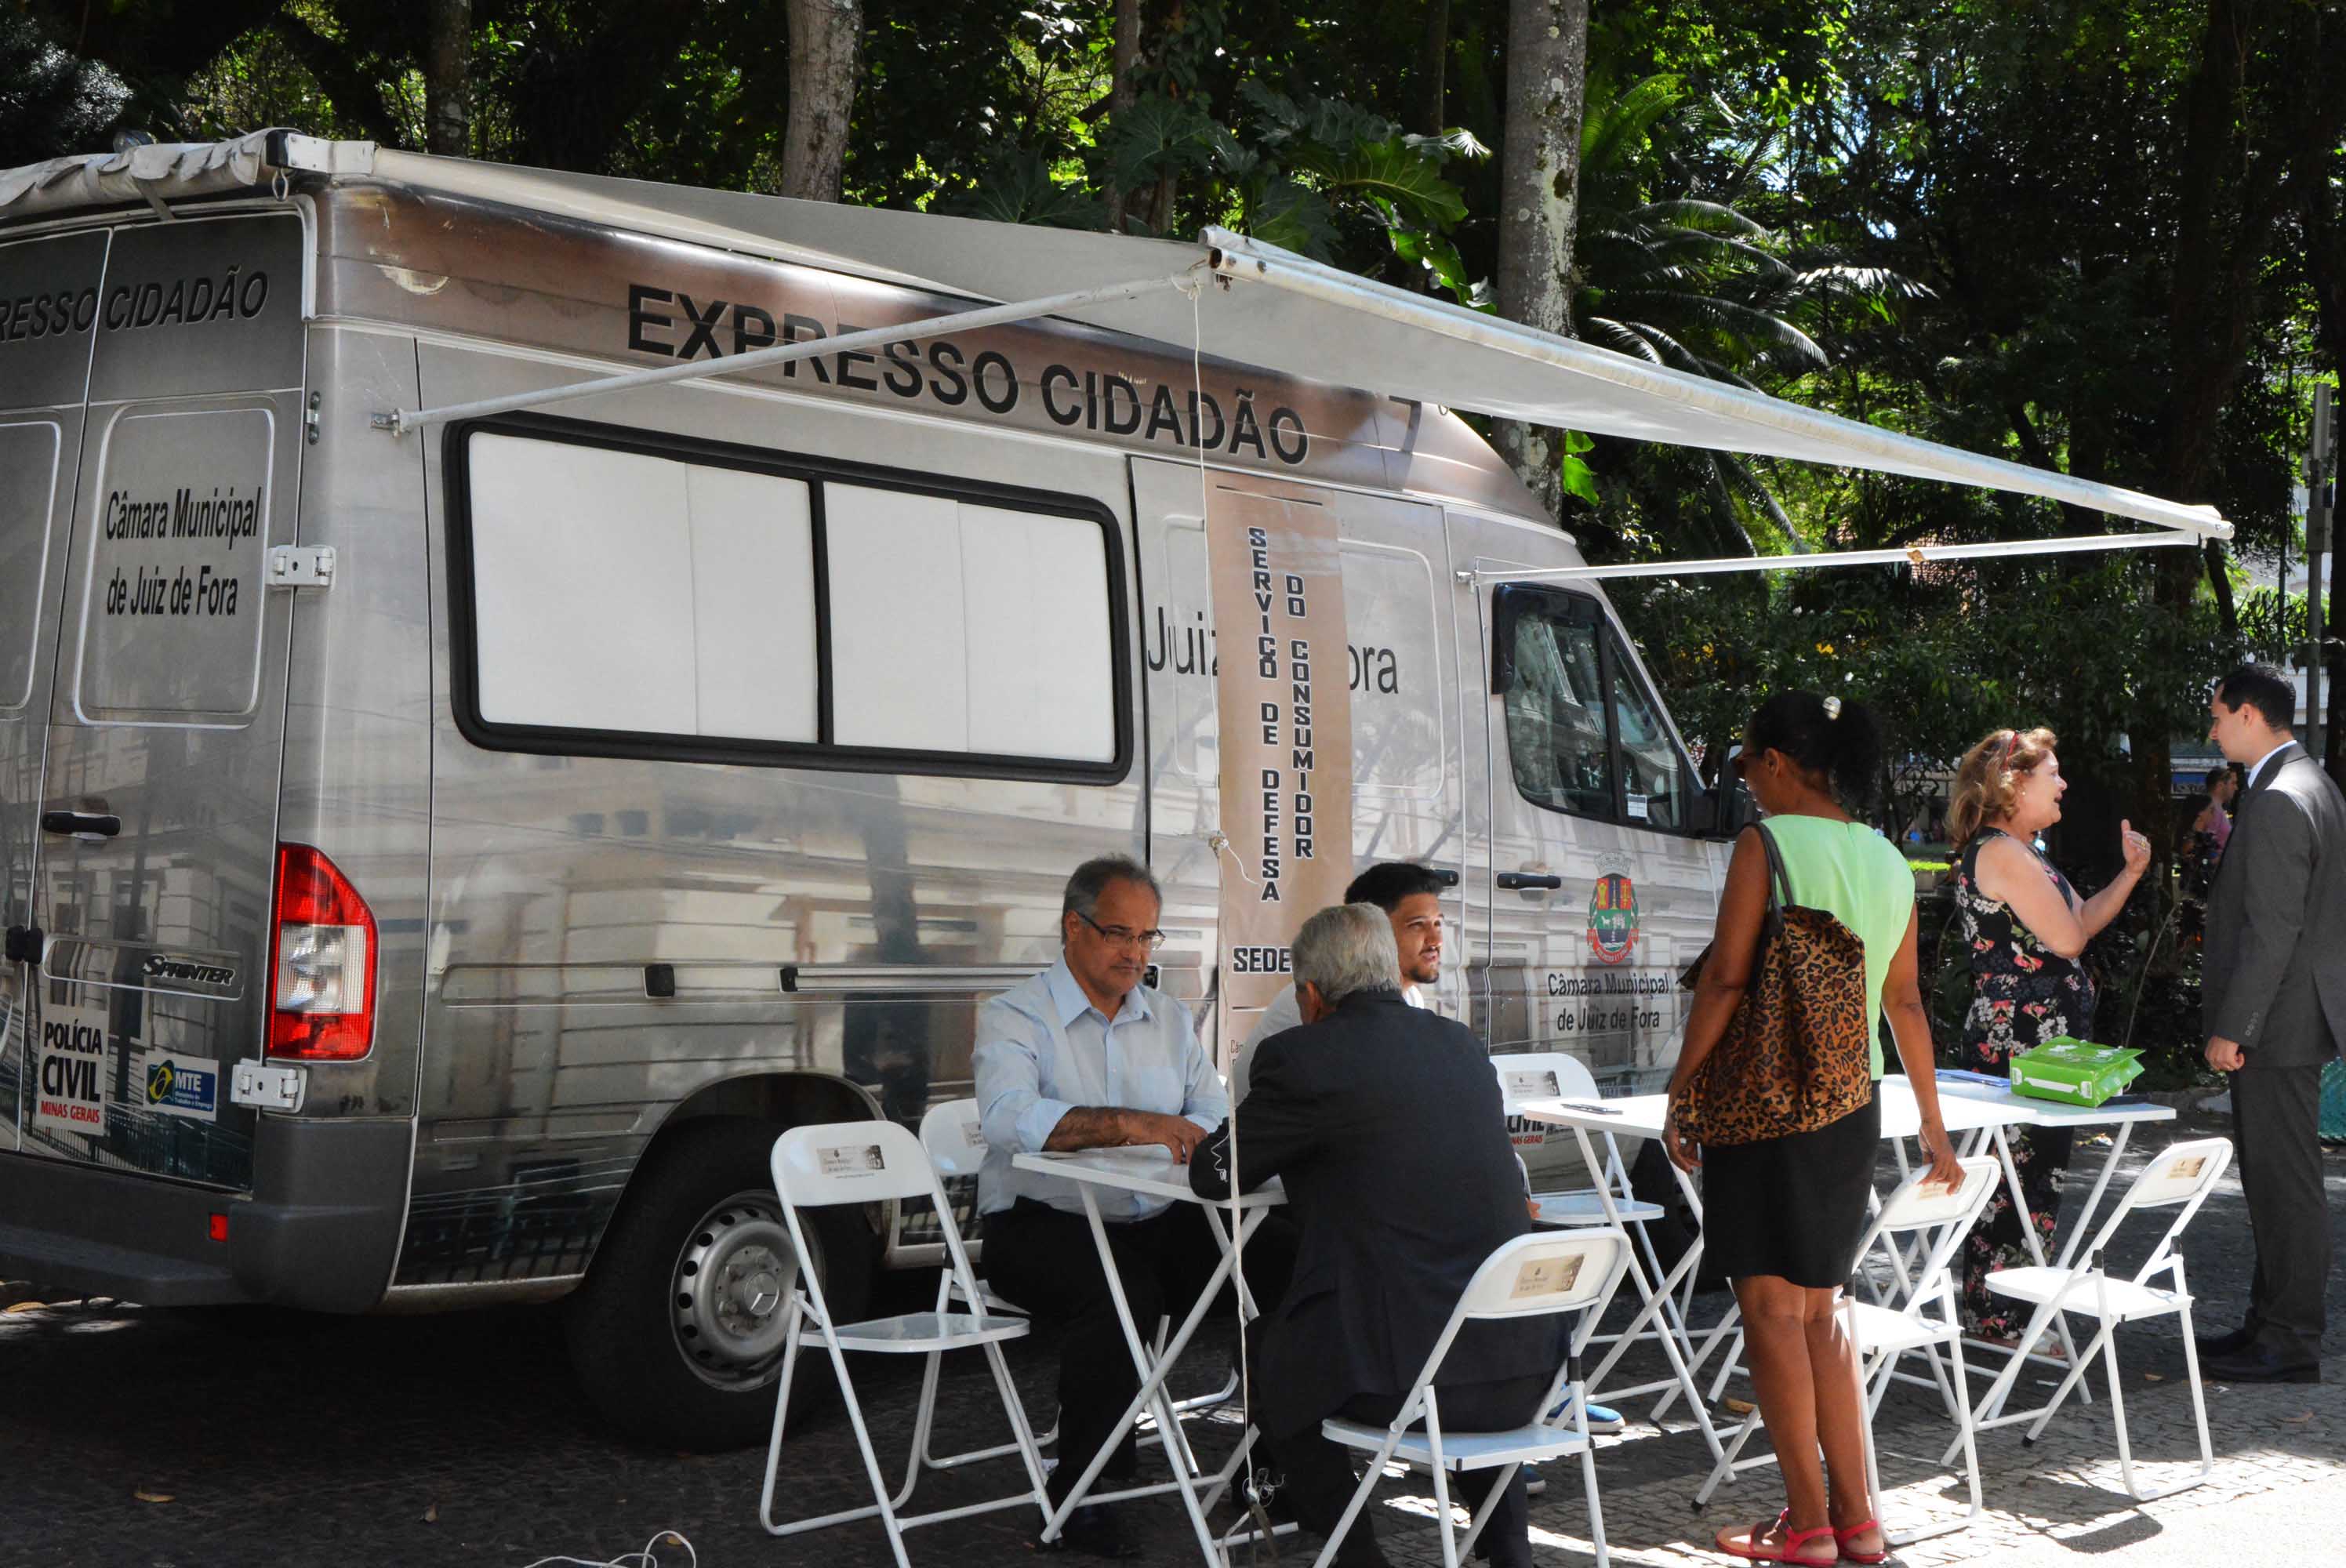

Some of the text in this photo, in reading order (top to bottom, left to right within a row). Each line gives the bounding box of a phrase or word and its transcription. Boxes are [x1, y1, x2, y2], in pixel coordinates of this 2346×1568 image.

[105, 265, 268, 332] CIDADÃO
[628, 284, 1309, 465] EXPRESSO CIDADÃO
[107, 487, 261, 550] Câmara Municipal
[107, 564, 238, 615] de Juiz de Fora
[1349, 644, 1399, 694] ora
[1261, 702, 1280, 746] DE
[1285, 574, 1314, 858] DO CONSUMIDOR
[1260, 768, 1280, 902] DEFESA
[1549, 972, 1669, 1000] Câmara Municipal
[44, 1018, 103, 1054] POLÍCIA
[1557, 1006, 1660, 1031] de Juiz de Fora
[42, 1055, 100, 1102] CIVIL
[175, 1071, 202, 1092] MTE
[41, 1101, 100, 1123] MINAS GERAIS
